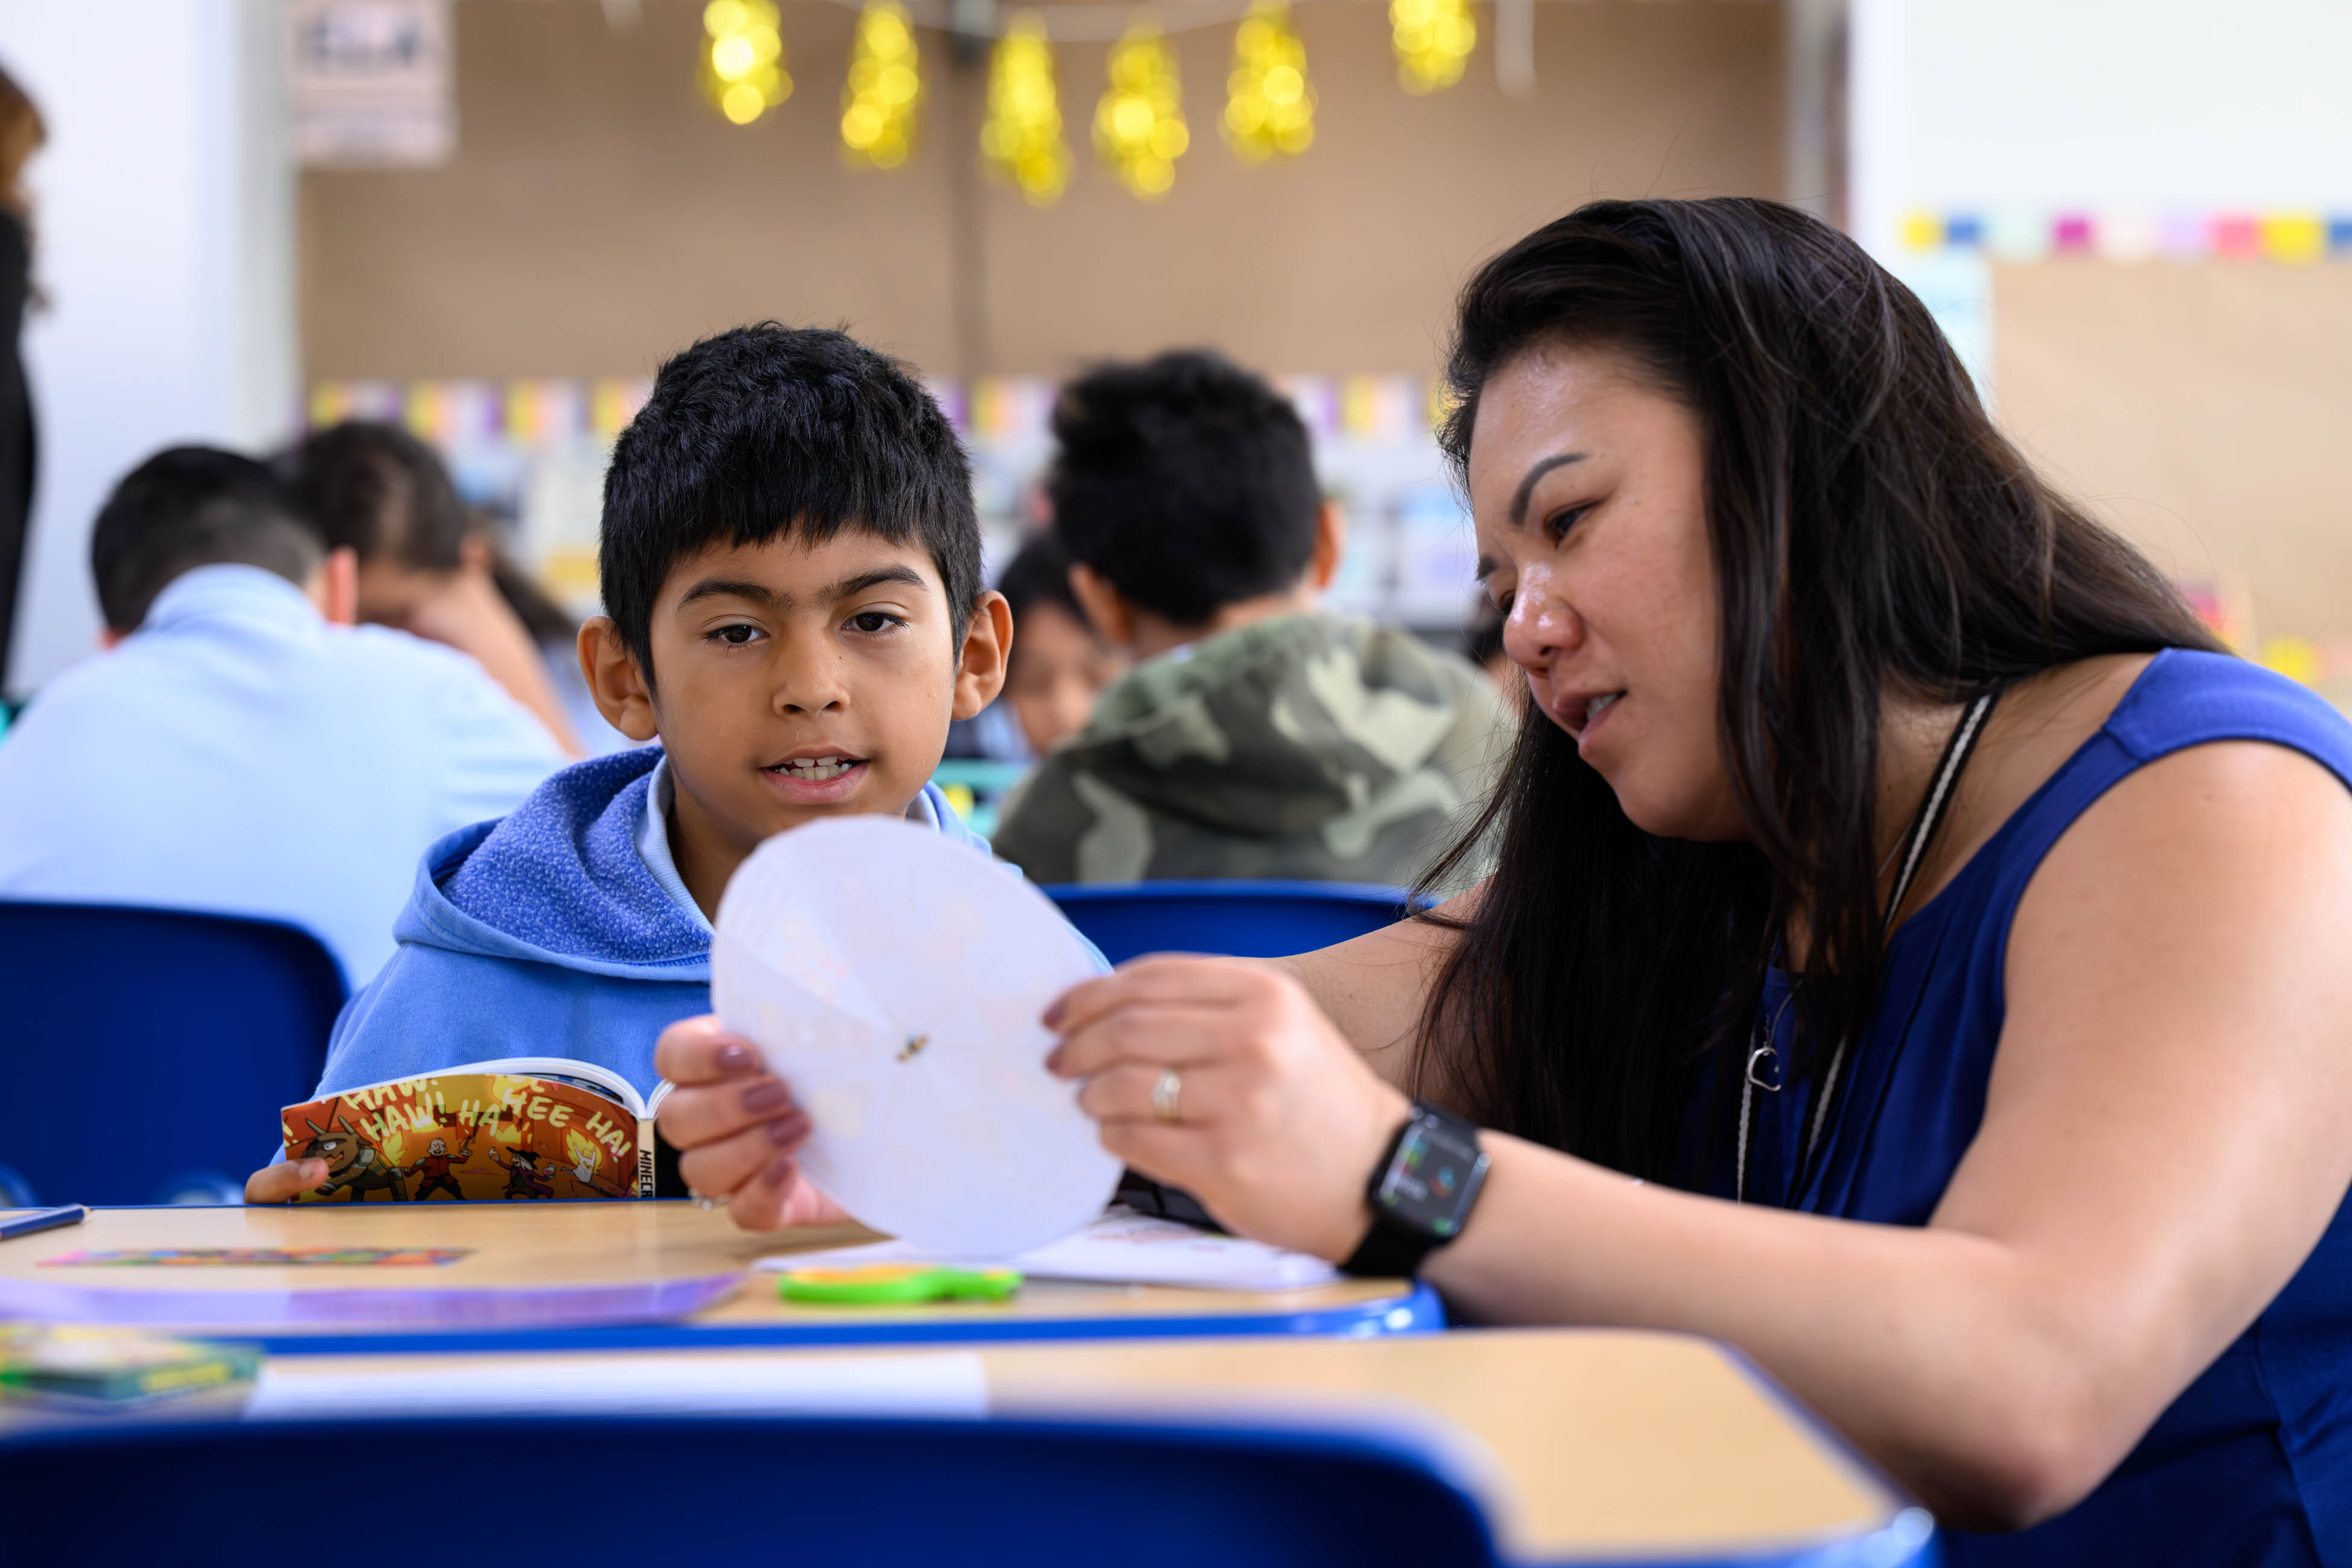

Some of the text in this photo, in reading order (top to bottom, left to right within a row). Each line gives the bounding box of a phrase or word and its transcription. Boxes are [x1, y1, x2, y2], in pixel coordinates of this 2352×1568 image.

[360, 1087, 632, 1163] HAW! HA HEE HA!
